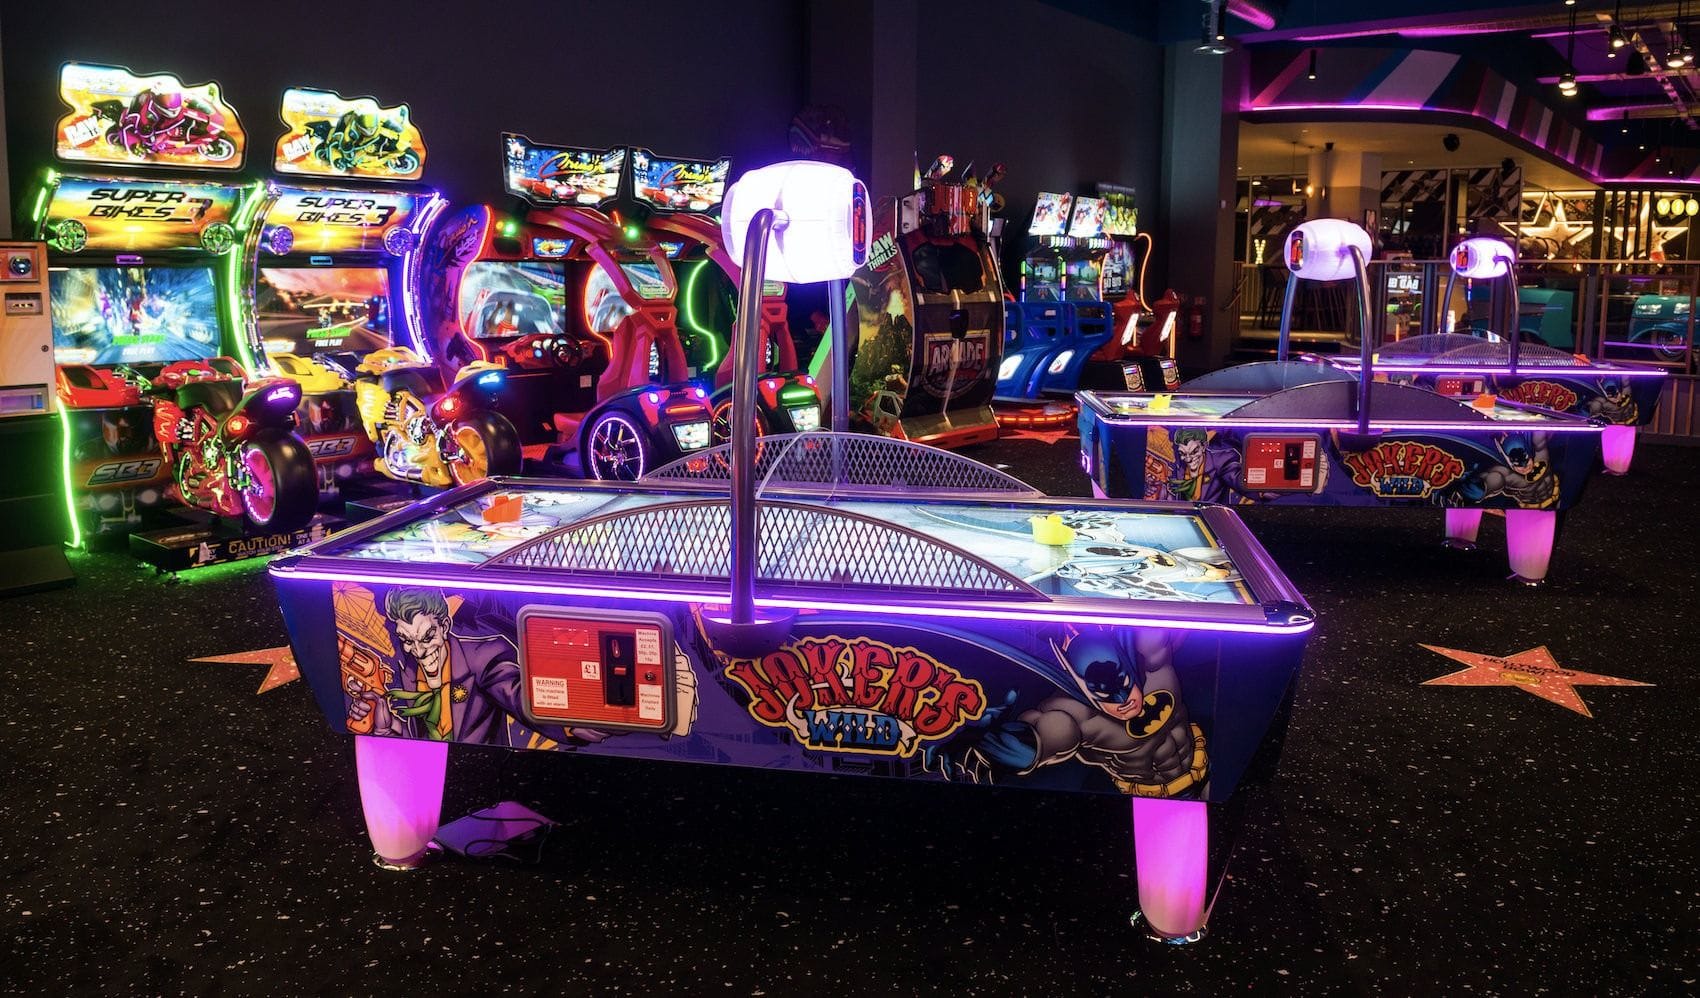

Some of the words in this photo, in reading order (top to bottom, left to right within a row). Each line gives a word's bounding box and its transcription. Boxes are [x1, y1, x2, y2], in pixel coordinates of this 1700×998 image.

[88, 187, 187, 203] SUPER
[296, 196, 376, 211] SUPER
[88, 205, 175, 219] BIKES
[296, 211, 365, 223] BIKES
[373, 205, 397, 226] 3
[867, 245, 898, 272] THRILLS
[94, 460, 160, 483] SB3
[1380, 476, 1424, 495] WILD
[228, 534, 291, 554] CAUTION!
[584, 664, 597, 674] £1
[1482, 658, 1576, 677] HOLLYWOOD
[535, 679, 565, 687] WARNING
[804, 710, 899, 747] WILD
